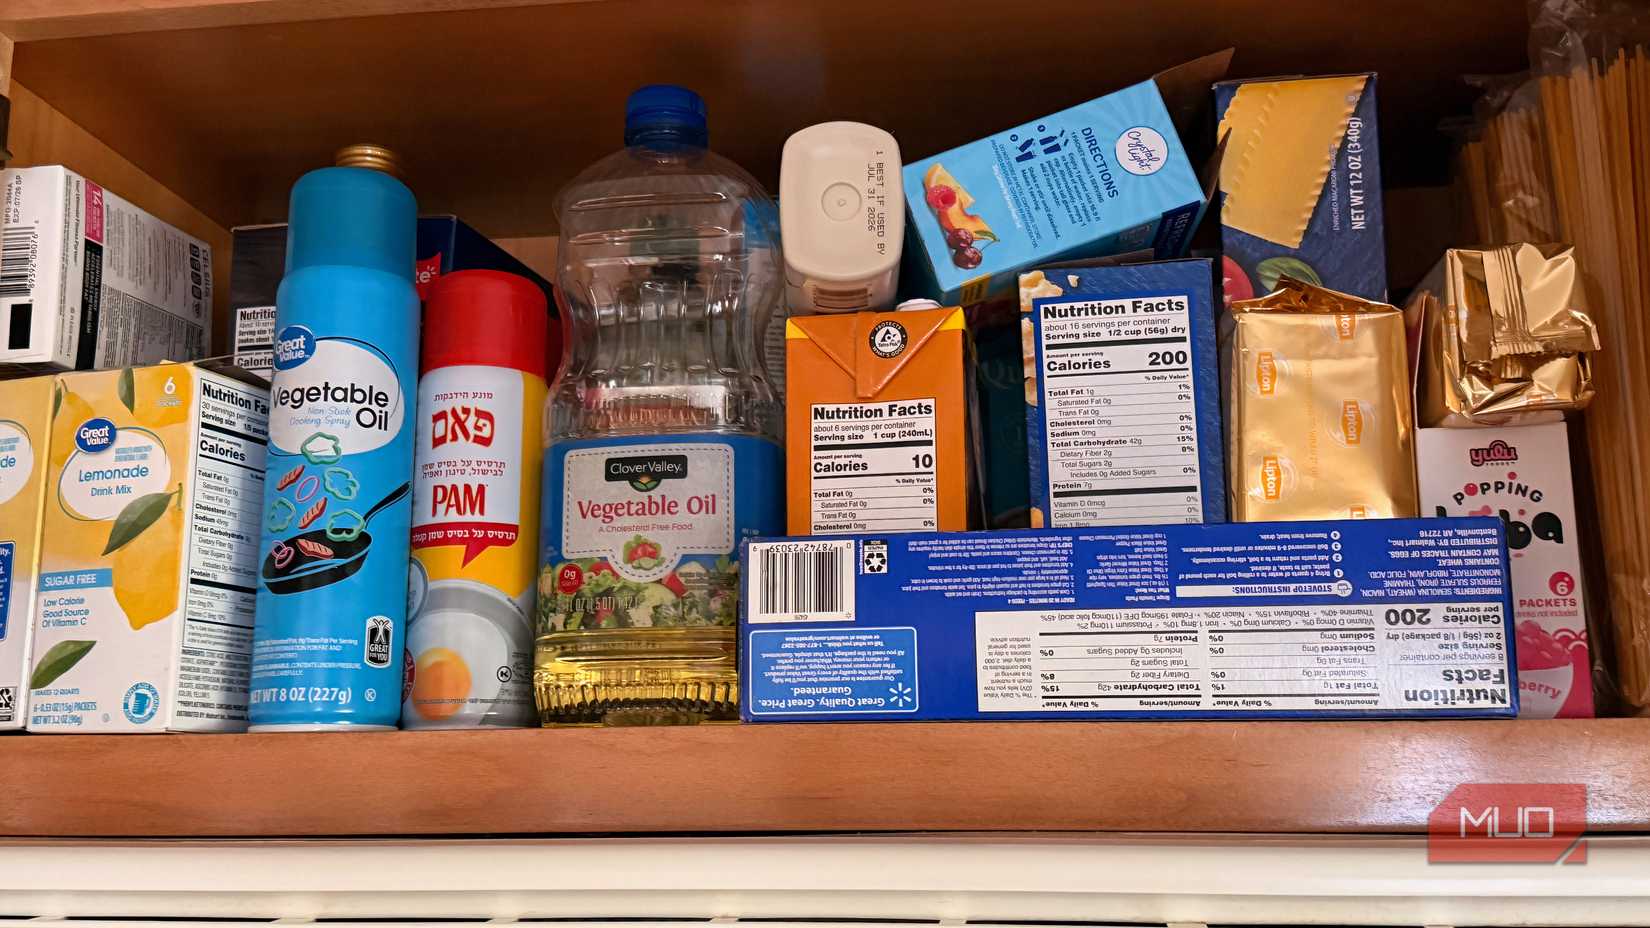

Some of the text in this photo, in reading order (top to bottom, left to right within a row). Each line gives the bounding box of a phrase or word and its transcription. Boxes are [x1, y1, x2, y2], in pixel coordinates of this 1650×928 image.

[1127, 131, 1160, 163] Crystal
[1081, 126, 1119, 200] DIRECTIONS
[1347, 117, 1366, 230] NET WT 12 OZ (340g)
[868, 188, 876, 199] 31
[876, 196, 884, 206] IF
[877, 212, 885, 237] USED
[877, 243, 885, 255] BY
[1043, 299, 1185, 320] Nutrition Facts
[1044, 322, 1068, 332] about
[1082, 320, 1116, 331] servings
[1118, 320, 1131, 330] per
[1132, 317, 1170, 326] container
[1045, 326, 1186, 342] Serving size 1/2 cup (56g) dry
[1047, 350, 1188, 372] Calories 200
[164, 378, 176, 394] 6
[1048, 390, 1068, 398] Total
[1087, 388, 1095, 396] 1g
[203, 382, 252, 409] Nutrition
[272, 382, 389, 410] Vegetable
[813, 402, 932, 420] Nutrition Facts
[356, 408, 389, 431] Oil
[840, 424, 870, 433] servings
[871, 423, 882, 432] per
[884, 421, 916, 430] container
[1050, 419, 1095, 429] Cholesterol
[1097, 418, 1112, 428] 0mg
[1347, 404, 1358, 441] Lipton
[80, 426, 110, 439] Great
[432, 406, 494, 450] פאם
[1050, 430, 1096, 438] Sodium 0mg
[87, 437, 110, 446] Value
[814, 434, 845, 443] Serving
[880, 432, 896, 440] cup
[898, 429, 933, 438] (240mL)
[1050, 440, 1072, 448] Total
[1072, 438, 1128, 448] Carbohydrate
[1130, 438, 1143, 446] 42g
[200, 440, 246, 462] Calories
[1470, 440, 1518, 467] yulu
[610, 460, 682, 475] Clover Valley
[814, 454, 933, 473] Calories 10
[79, 465, 149, 482] Lemonade
[1266, 460, 1276, 496] Lipton
[91, 485, 132, 496] Drink Mix
[1053, 482, 1092, 490] Protein 7g
[1453, 480, 1543, 505] POPPING
[432, 483, 487, 518] PAM
[578, 494, 716, 524] Vegetable Oil
[448, 530, 470, 539] בסיס
[813, 523, 852, 532] Cholesterol
[488, 531, 516, 541] תרסיס
[769, 543, 832, 552] 78742 23039
[44, 574, 96, 586] SUGAR FREE
[1556, 577, 1568, 594] 6
[44, 598, 58, 607] Low
[1445, 605, 1481, 613] serving
[1520, 598, 1577, 608] PACKETS
[44, 610, 63, 618] Good
[1384, 607, 1500, 625] Calories 200
[369, 644, 389, 652] GREAT
[1441, 668, 1505, 685] Facts
[263, 687, 352, 704] WT 8 OZ (227g)
[790, 686, 851, 695] Guaranteed.
[1404, 687, 1506, 705] Nutrition
[758, 696, 884, 707] Great Quality. Great Price.
